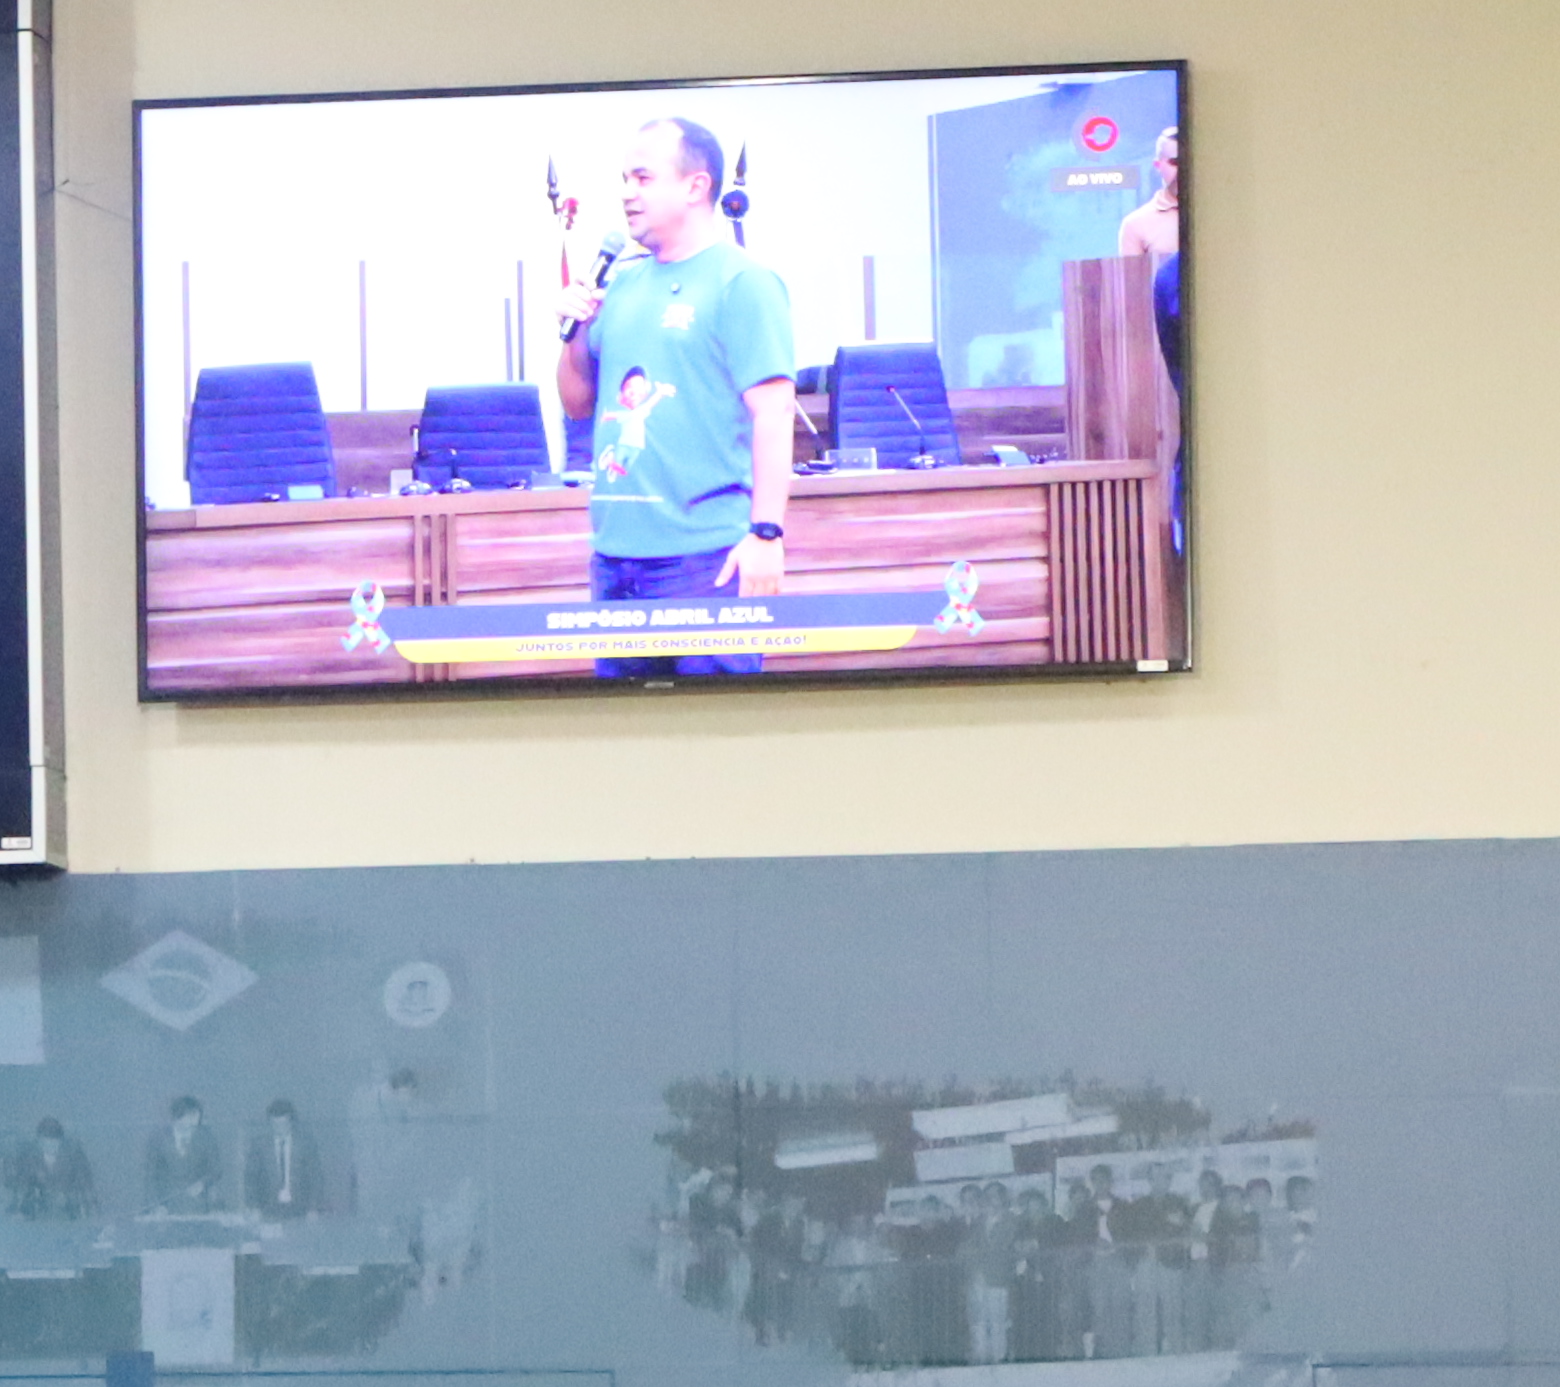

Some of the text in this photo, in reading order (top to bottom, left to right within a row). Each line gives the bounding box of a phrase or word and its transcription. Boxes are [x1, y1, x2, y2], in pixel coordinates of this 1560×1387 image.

[650, 608, 715, 626] ABRIL
[718, 606, 774, 624] AZUL
[516, 640, 574, 652] JUNTOS
[579, 640, 608, 650] POR
[613, 639, 646, 650] MAIS
[750, 636, 759, 646] E
